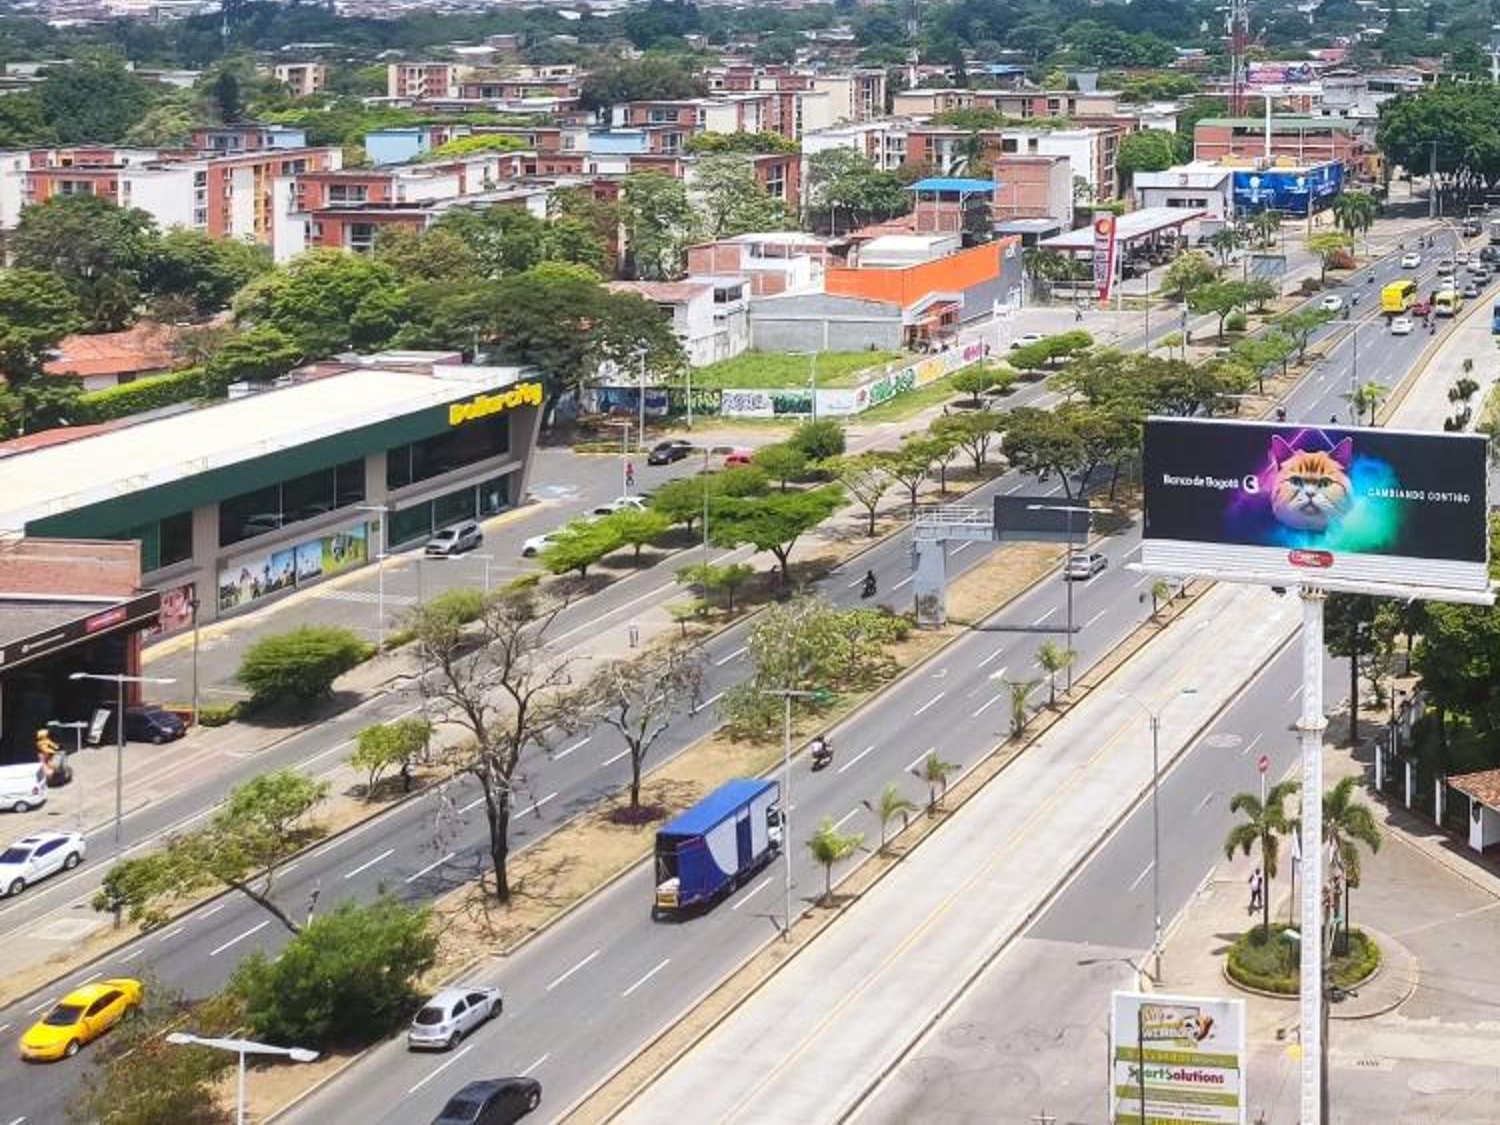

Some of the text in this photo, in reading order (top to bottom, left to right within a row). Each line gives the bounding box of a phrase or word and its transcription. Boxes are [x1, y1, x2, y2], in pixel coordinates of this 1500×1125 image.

[1163, 474, 1192, 486] Banco
[1193, 475, 1204, 486] de
[1367, 487, 1471, 504] CAMBIANDO CONTIGO
